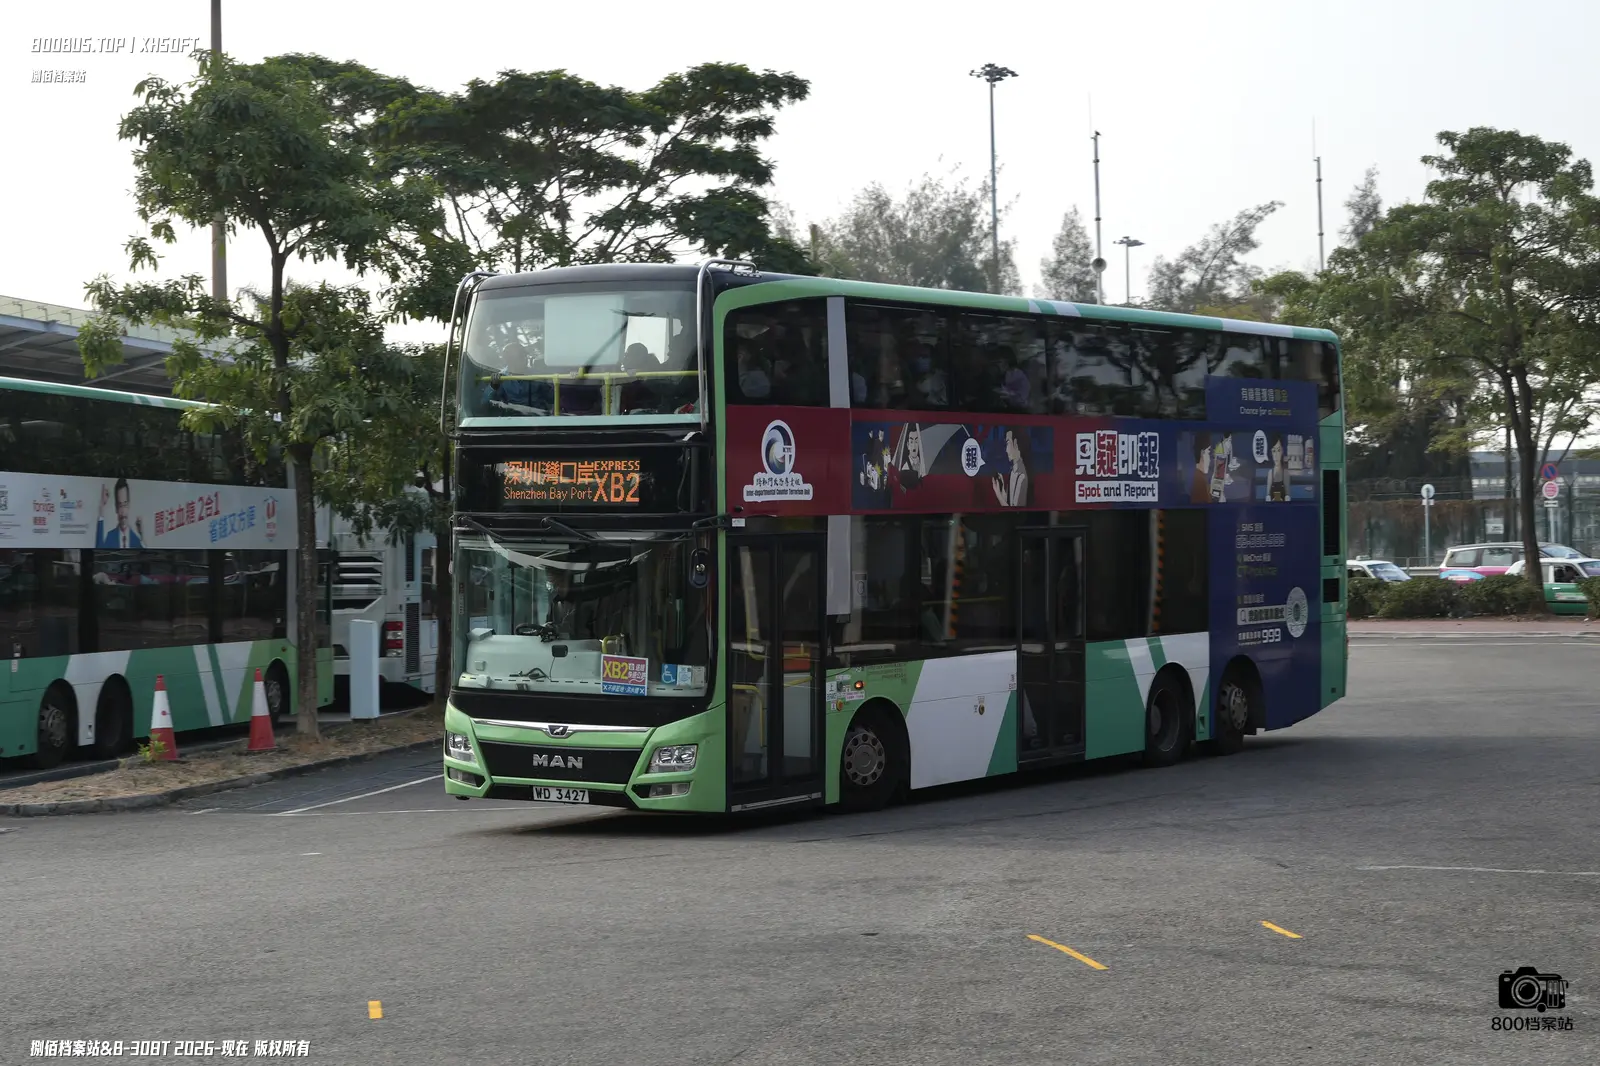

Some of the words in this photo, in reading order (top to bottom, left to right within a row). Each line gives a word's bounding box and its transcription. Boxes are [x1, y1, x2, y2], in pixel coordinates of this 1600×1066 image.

[965, 446, 978, 470] 報
[1075, 430, 1159, 478] 見疑即報
[504, 460, 594, 485] 深圳灣口岸
[594, 460, 640, 471] EXPRESS
[504, 486, 547, 500] Shenzhen
[549, 487, 568, 502] Bay
[570, 487, 592, 500] Port
[593, 472, 640, 502] XB2
[1078, 484, 1101, 500] Spot
[1104, 483, 1121, 497] and
[1124, 483, 1156, 499] Report
[1262, 628, 1281, 644] 999
[603, 660, 628, 680] XB2
[533, 754, 583, 770] MAN
[535, 788, 551, 801] WD
[556, 788, 587, 802] 3427
